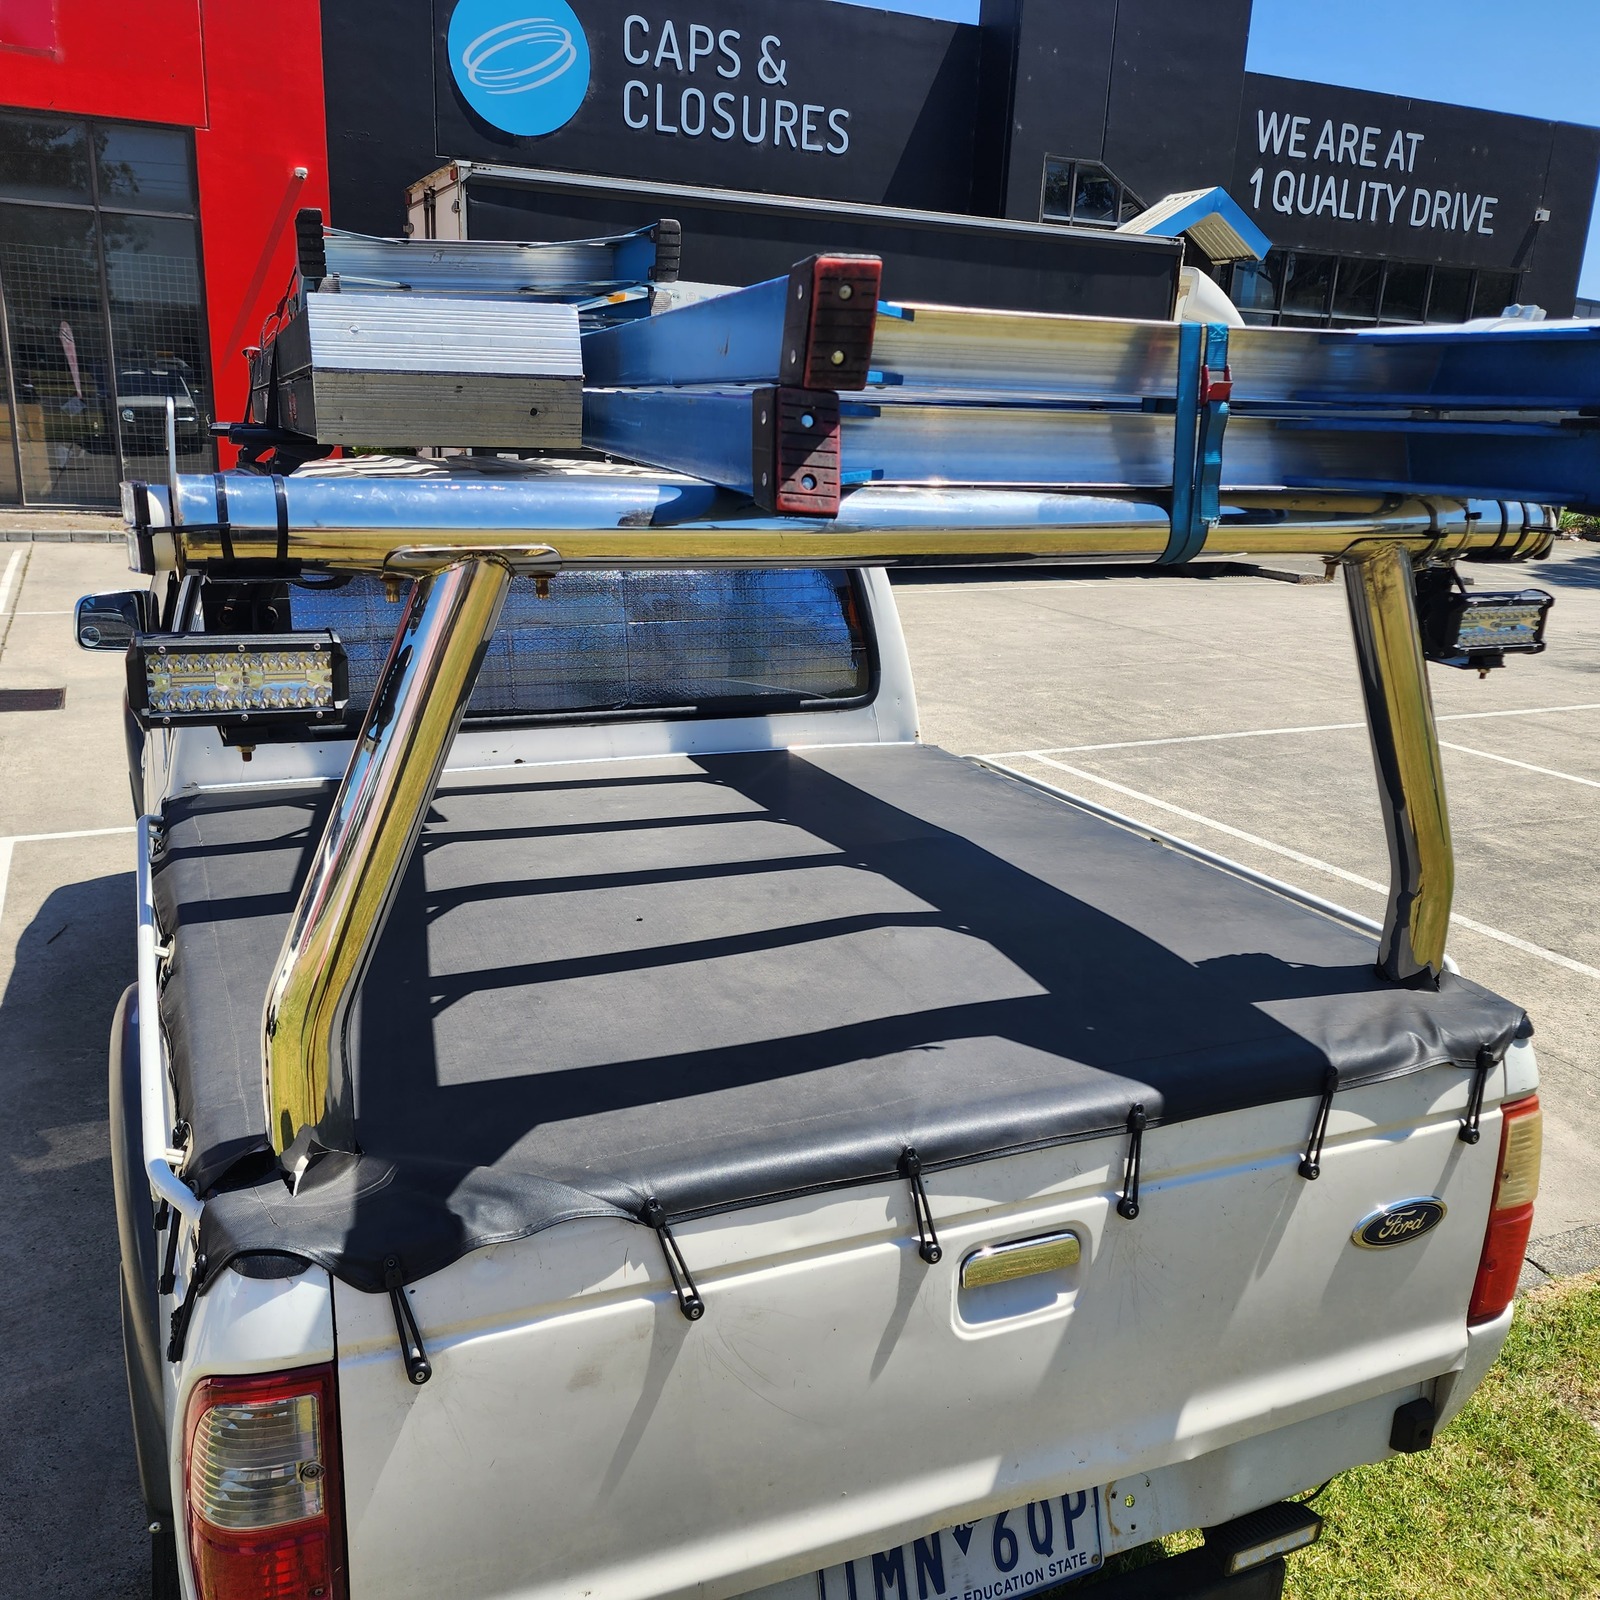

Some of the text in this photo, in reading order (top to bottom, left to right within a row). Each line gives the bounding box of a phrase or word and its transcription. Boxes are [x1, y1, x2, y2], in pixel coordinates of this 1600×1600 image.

[623, 14, 788, 86] CAPS &
[623, 79, 850, 155] CLOSURES
[1258, 109, 1425, 173] WE ARE AT
[1250, 167, 1499, 235] 1 QUALITY DRIVE
[1378, 1209, 1428, 1239] Ford
[963, 1552, 1088, 1600] EDUCATION STATE
